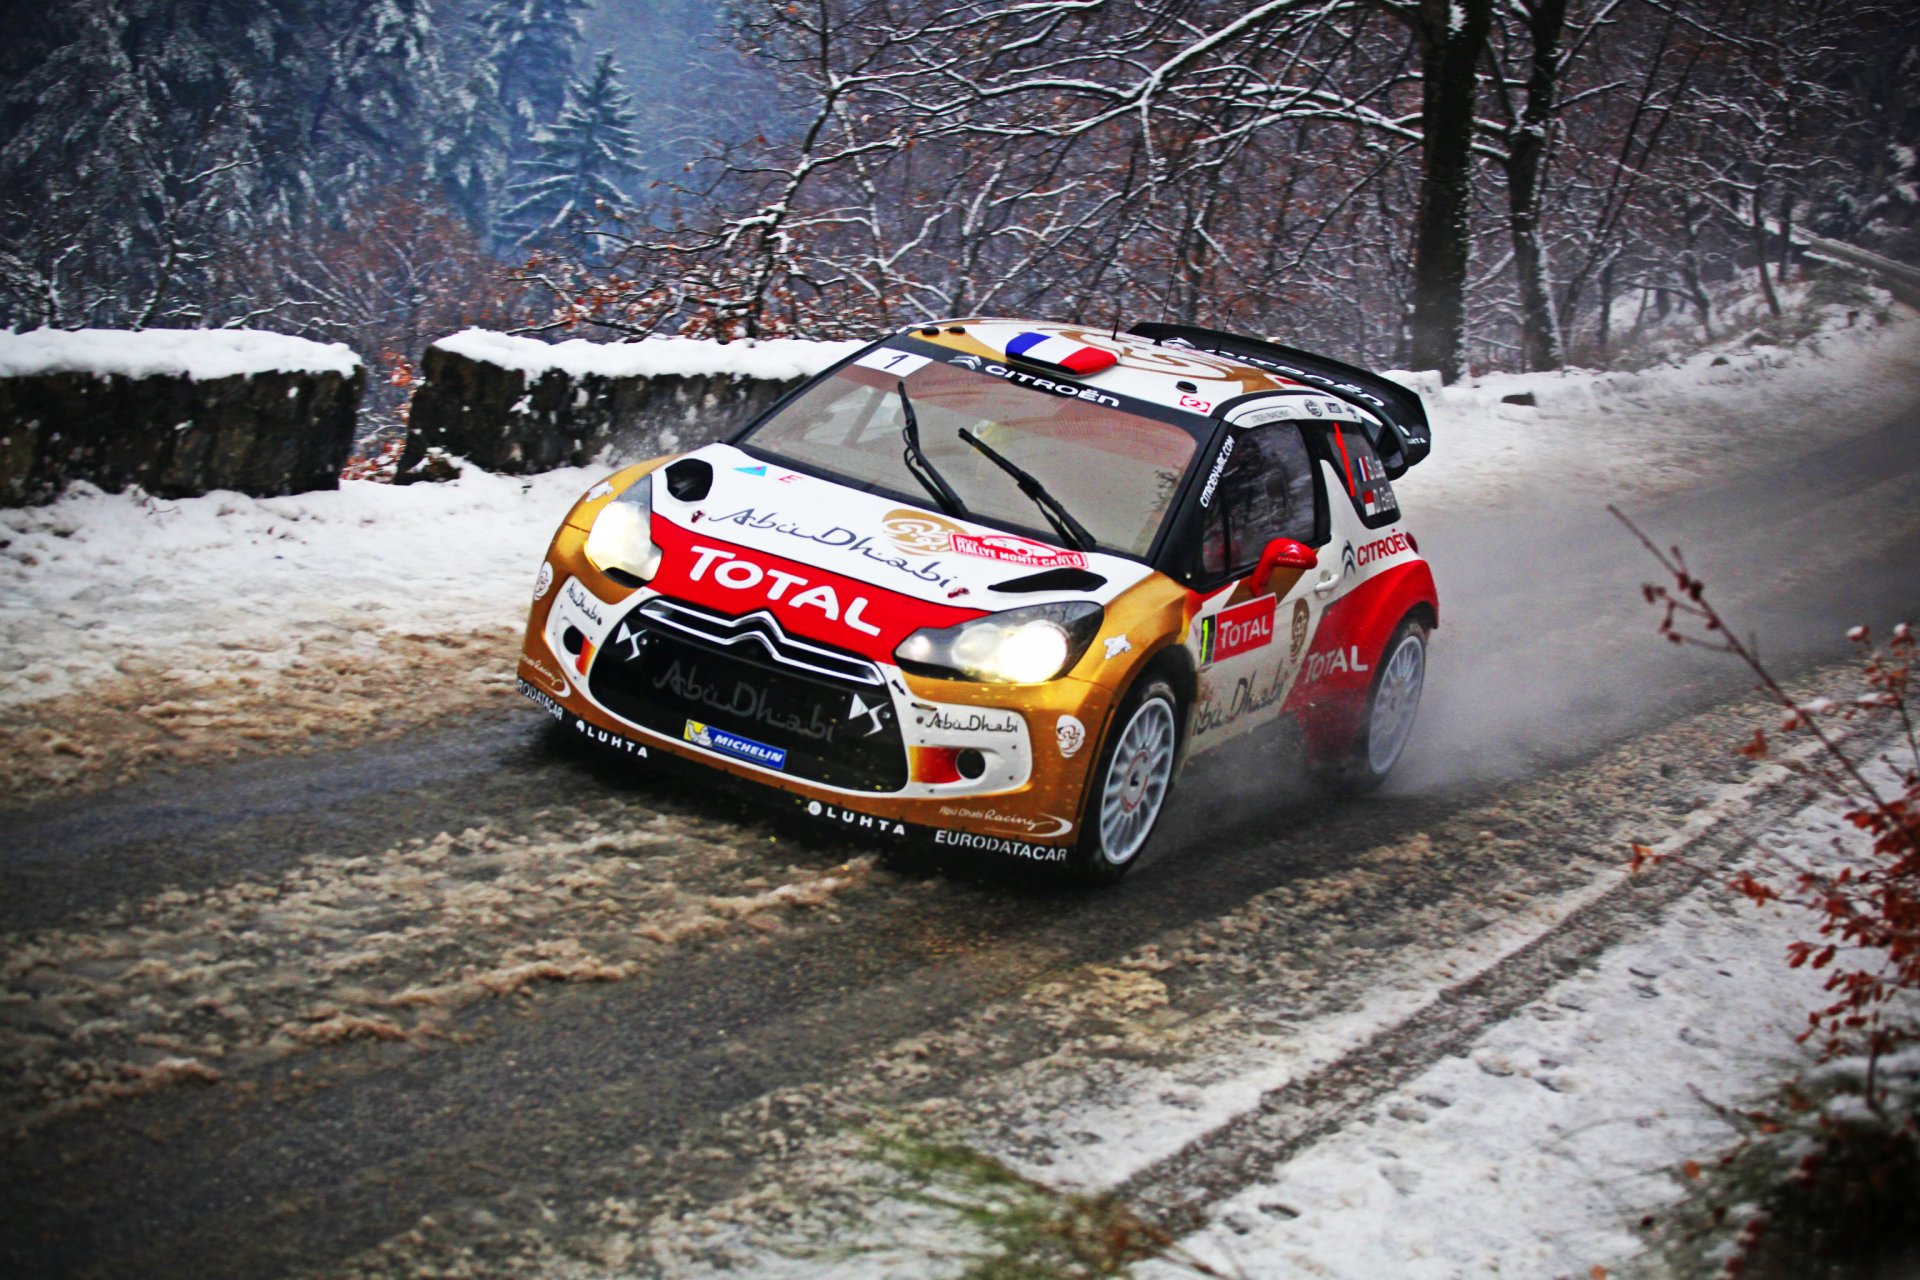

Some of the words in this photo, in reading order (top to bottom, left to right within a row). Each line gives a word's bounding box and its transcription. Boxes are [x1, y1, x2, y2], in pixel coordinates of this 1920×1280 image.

[884, 354, 910, 370] 1
[1000, 552, 1038, 565] MONTE
[690, 545, 881, 637] TOTAL
[1201, 618, 1209, 663] 1
[1220, 615, 1270, 649] TOTAL
[1304, 645, 1368, 683] TOTAL
[587, 725, 648, 758] LUHTA
[714, 734, 784, 763] MICHELIN
[827, 808, 905, 836] LUHTA
[984, 808, 1037, 831] Racing
[934, 829, 1068, 861] EURODATACAR
